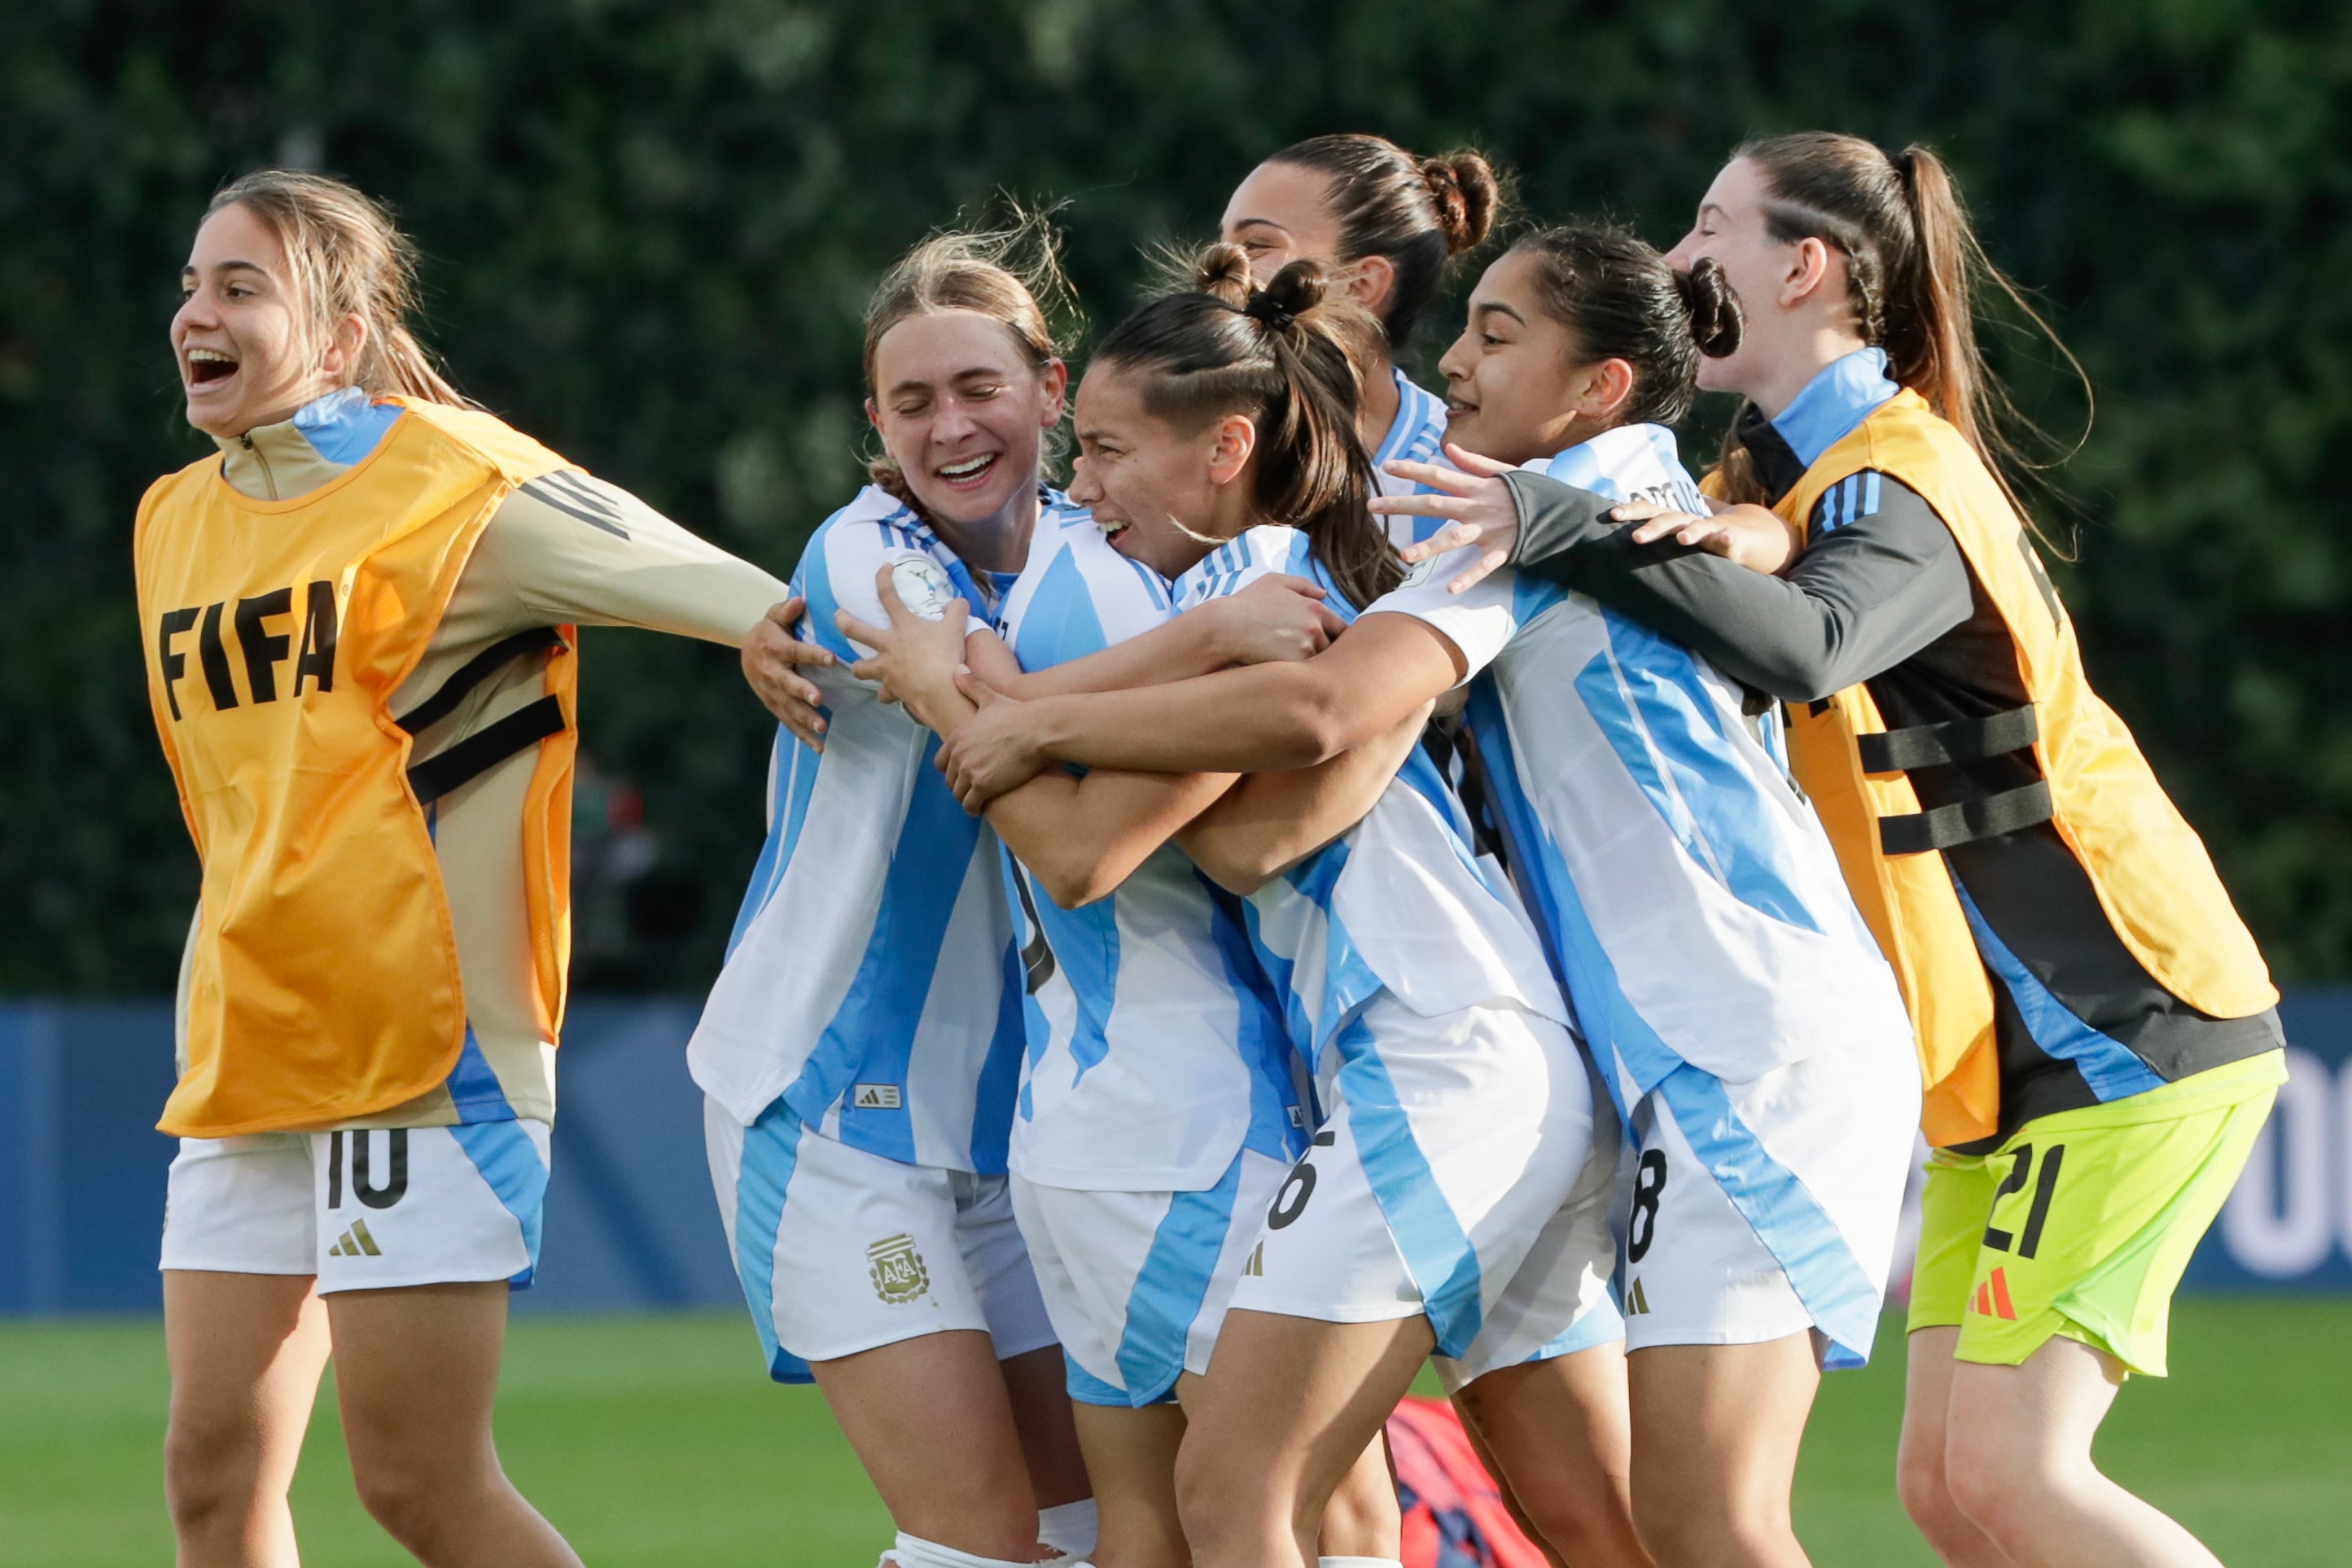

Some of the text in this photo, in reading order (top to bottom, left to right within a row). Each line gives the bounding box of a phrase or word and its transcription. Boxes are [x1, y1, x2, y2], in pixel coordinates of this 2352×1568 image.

[160, 580, 338, 722] FIFA
[328, 1128, 409, 1209] 10
[1628, 1148, 1667, 1264] 8
[1982, 1143, 2065, 1260] 21
